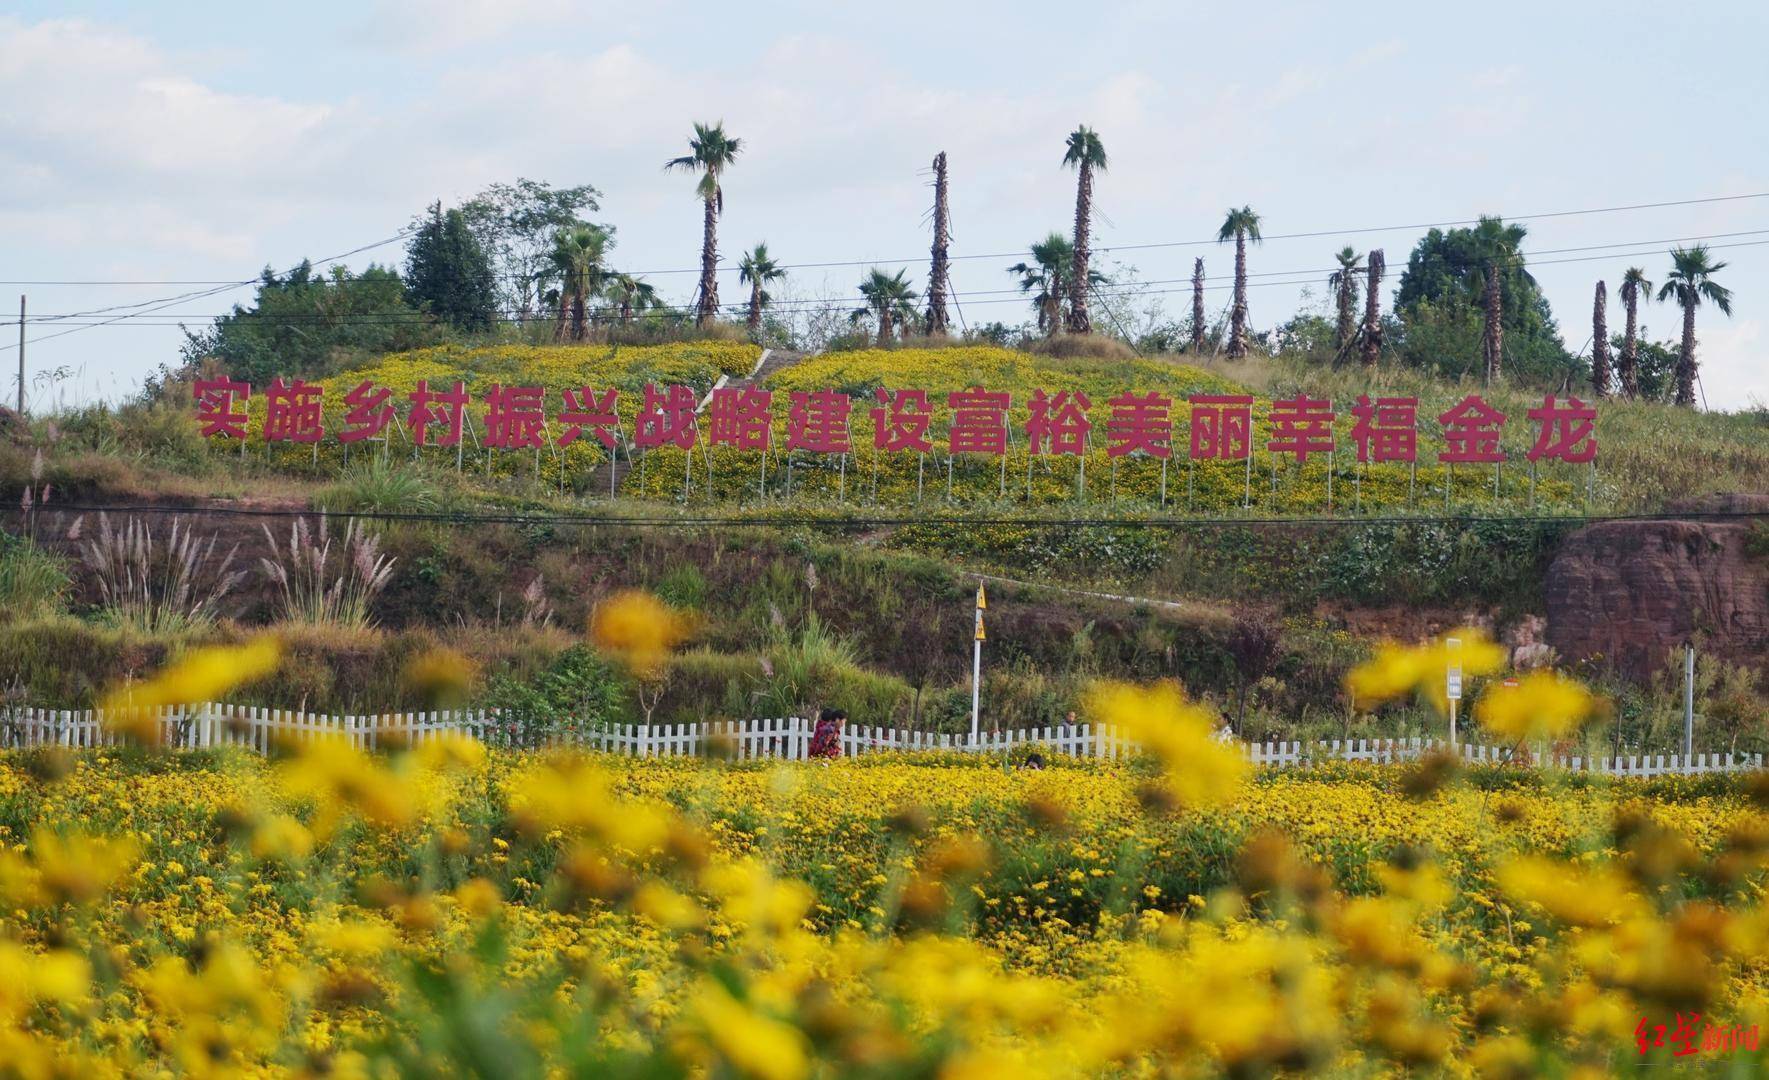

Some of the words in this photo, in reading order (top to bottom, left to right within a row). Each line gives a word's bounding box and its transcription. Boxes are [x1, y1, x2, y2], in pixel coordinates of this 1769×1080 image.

[193, 375, 1597, 463] 实施乡村振兴战略建设富裕美丽幸福金龙
